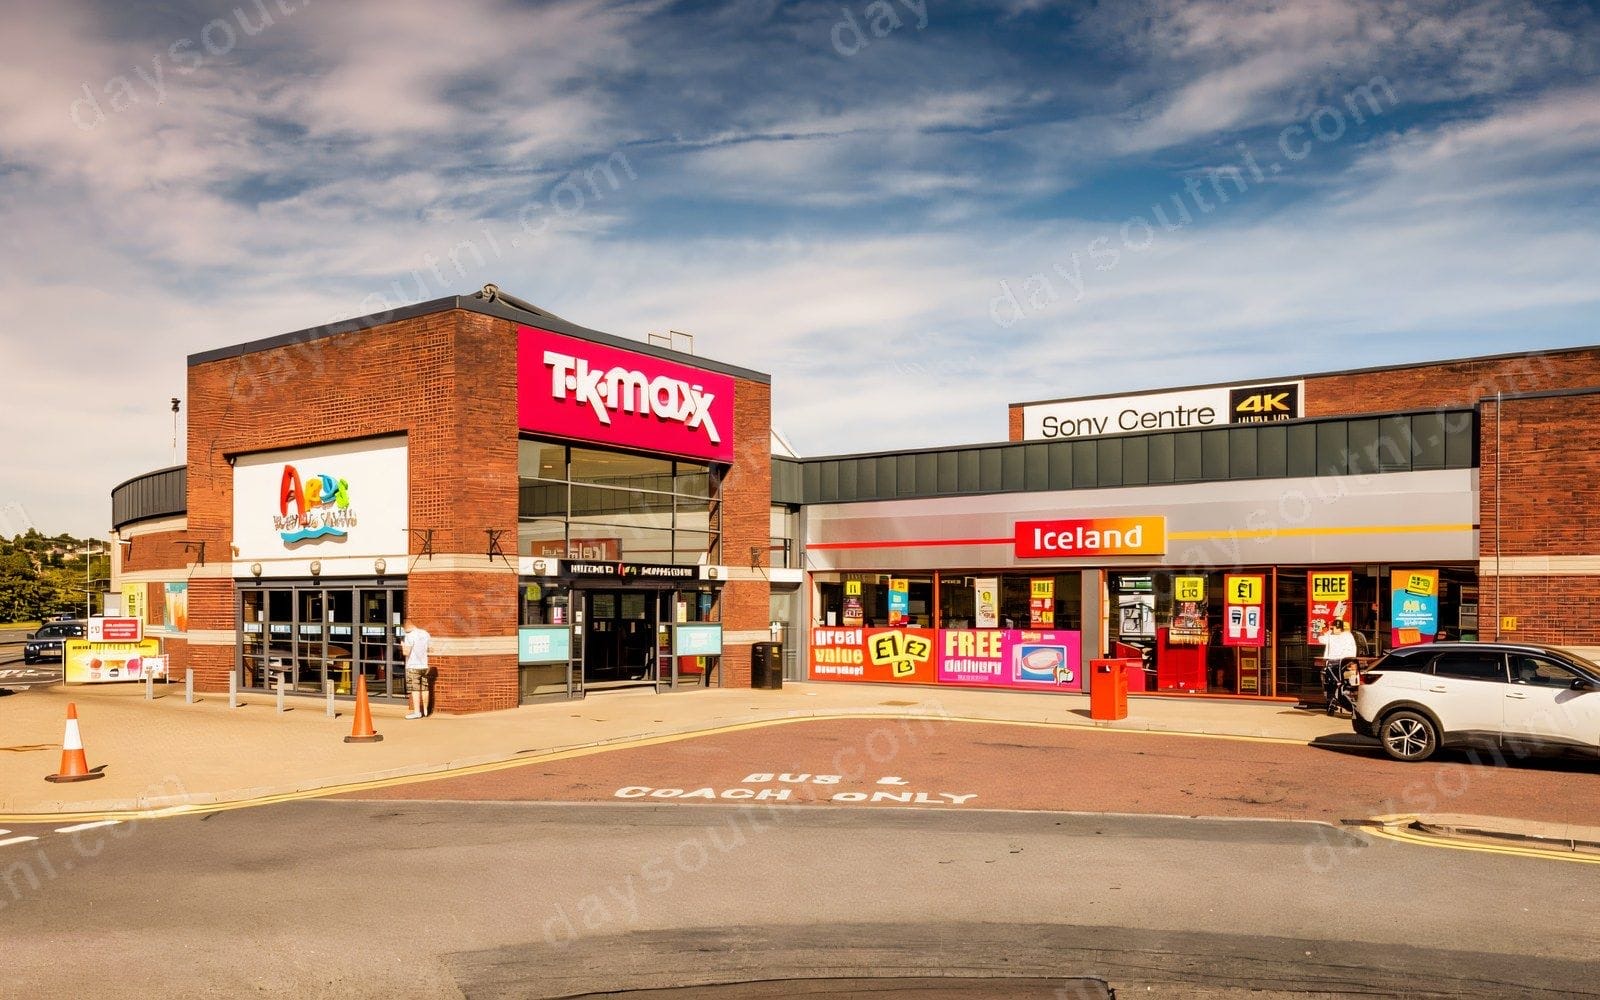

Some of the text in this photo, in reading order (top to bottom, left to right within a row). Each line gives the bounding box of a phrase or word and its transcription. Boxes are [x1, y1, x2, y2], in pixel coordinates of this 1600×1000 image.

[1236, 392, 1291, 412] 4K
[1042, 405, 1215, 438] Sony Centre
[1034, 525, 1142, 550] Iceland
[1314, 577, 1346, 593] FREE
[945, 630, 1002, 658] FREE
[741, 773, 843, 785] BUS
[614, 786, 979, 805] COACH ONLY
